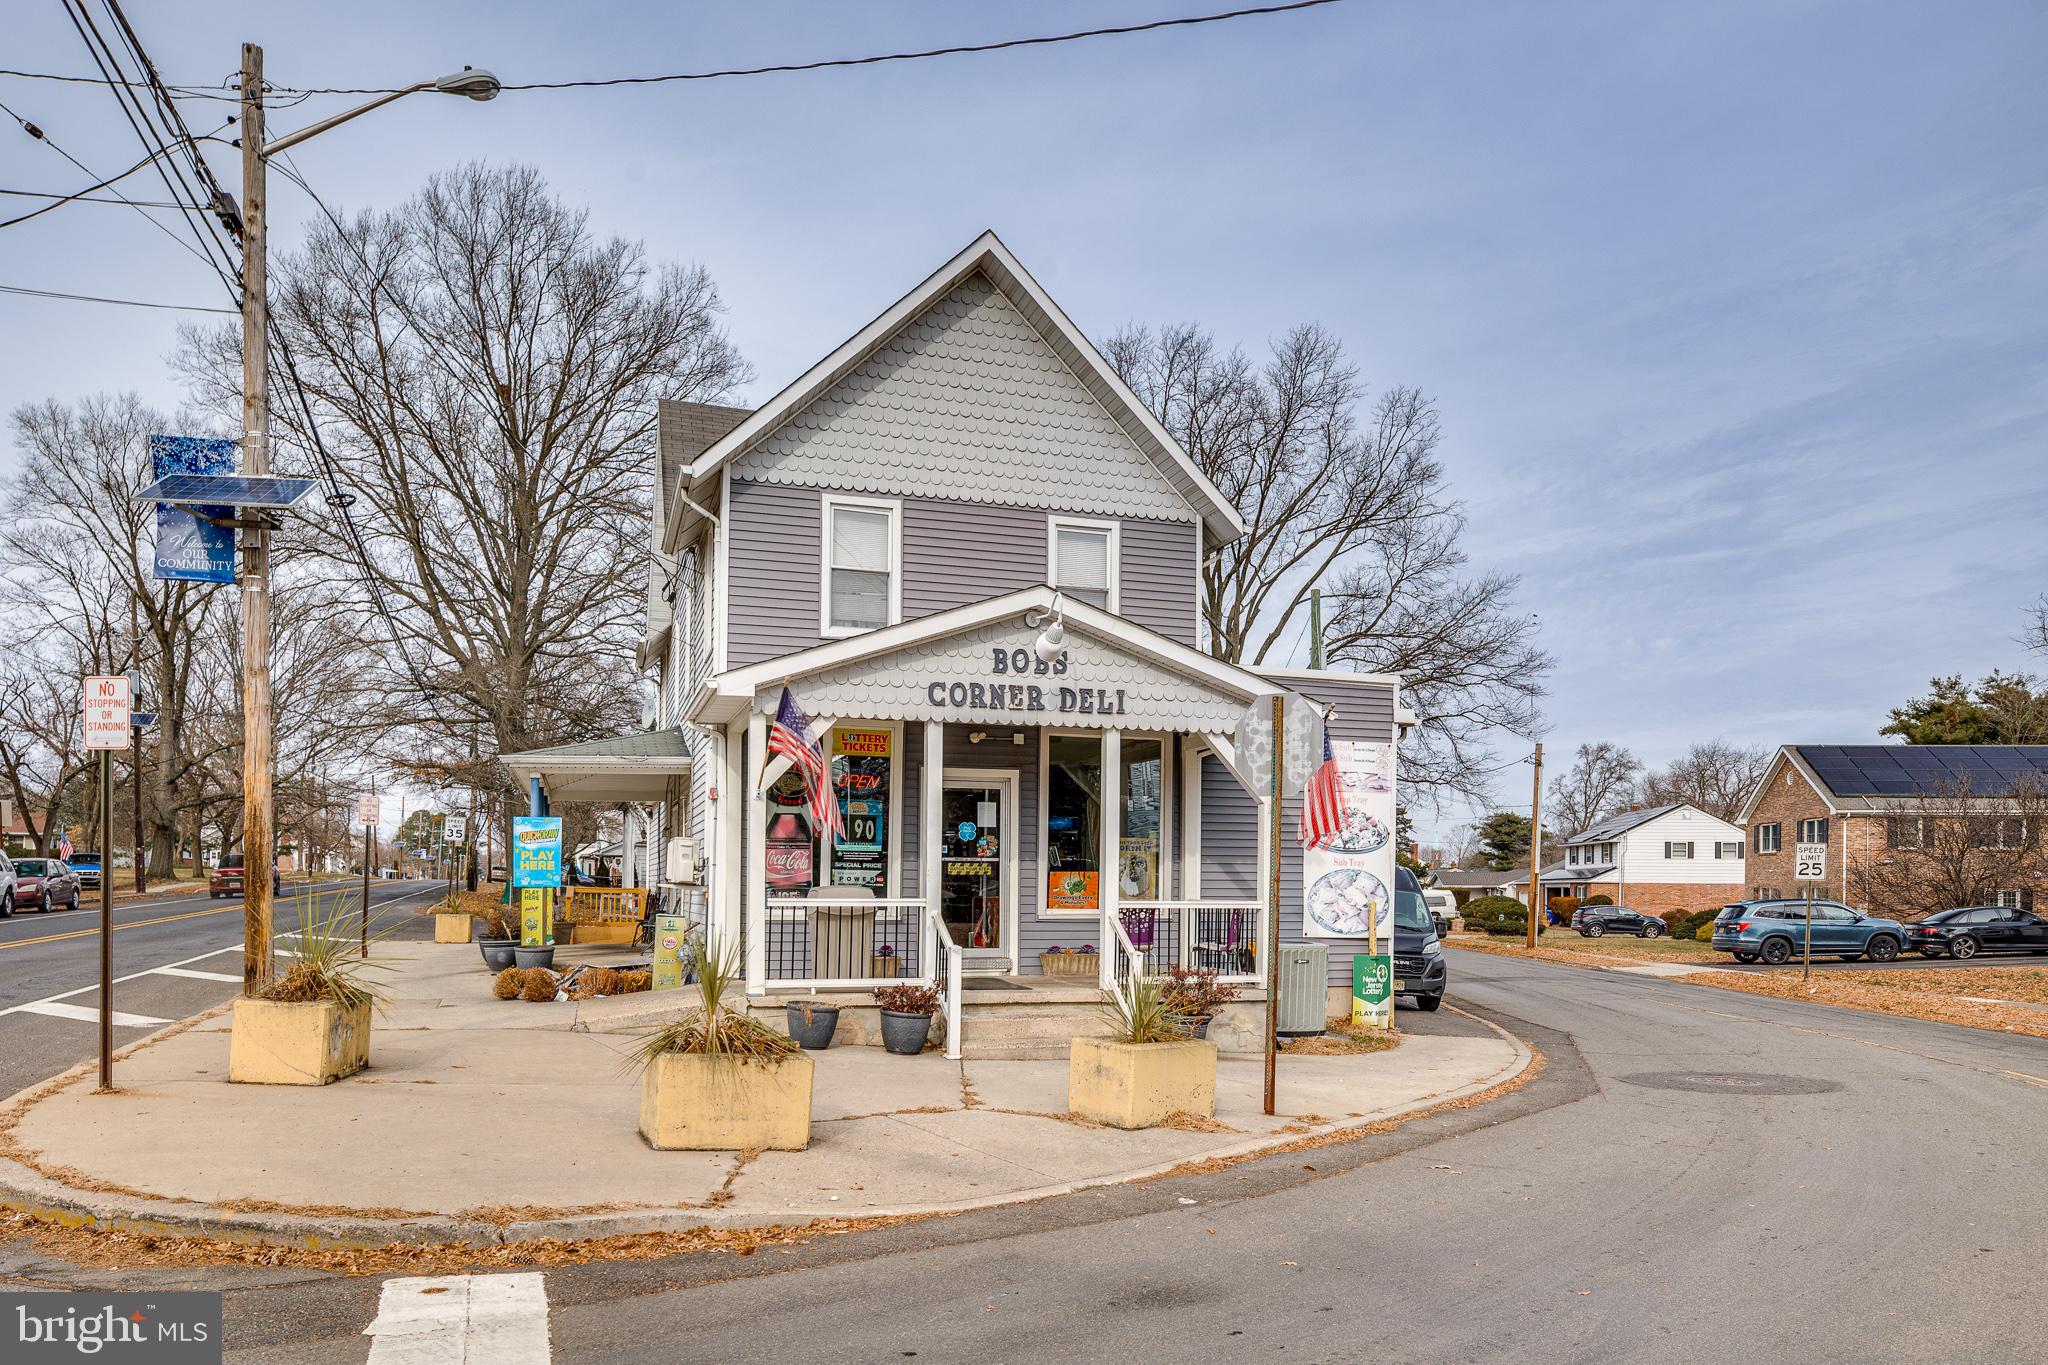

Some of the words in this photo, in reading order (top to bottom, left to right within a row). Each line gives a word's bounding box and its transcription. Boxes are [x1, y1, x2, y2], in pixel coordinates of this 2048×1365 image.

[169, 534, 214, 549] Welcome
[215, 539, 224, 549] to
[182, 549, 210, 560] OUR
[157, 558, 233, 572] COMMUNITY
[99, 683, 115, 697] NO
[87, 699, 126, 708] STOPPING
[927, 681, 1045, 711] CORNER
[1059, 687, 1126, 715] DELI
[101, 710, 113, 720] OR
[87, 722, 126, 732] STANDING
[842, 742, 887, 753] TICKETS
[836, 773, 881, 789] OPEN
[446, 828, 463, 839] 35
[854, 819, 875, 840] 90
[520, 850, 555, 861] PLAY
[1798, 846, 1825, 854] SPEED
[766, 849, 810, 870] Coca-Cola
[1332, 857, 1349, 868] Sub
[1349, 858, 1366, 868] Tray
[520, 860, 555, 871] HERE
[1798, 862, 1823, 877] 25
[1362, 987, 1384, 996] Lottery
